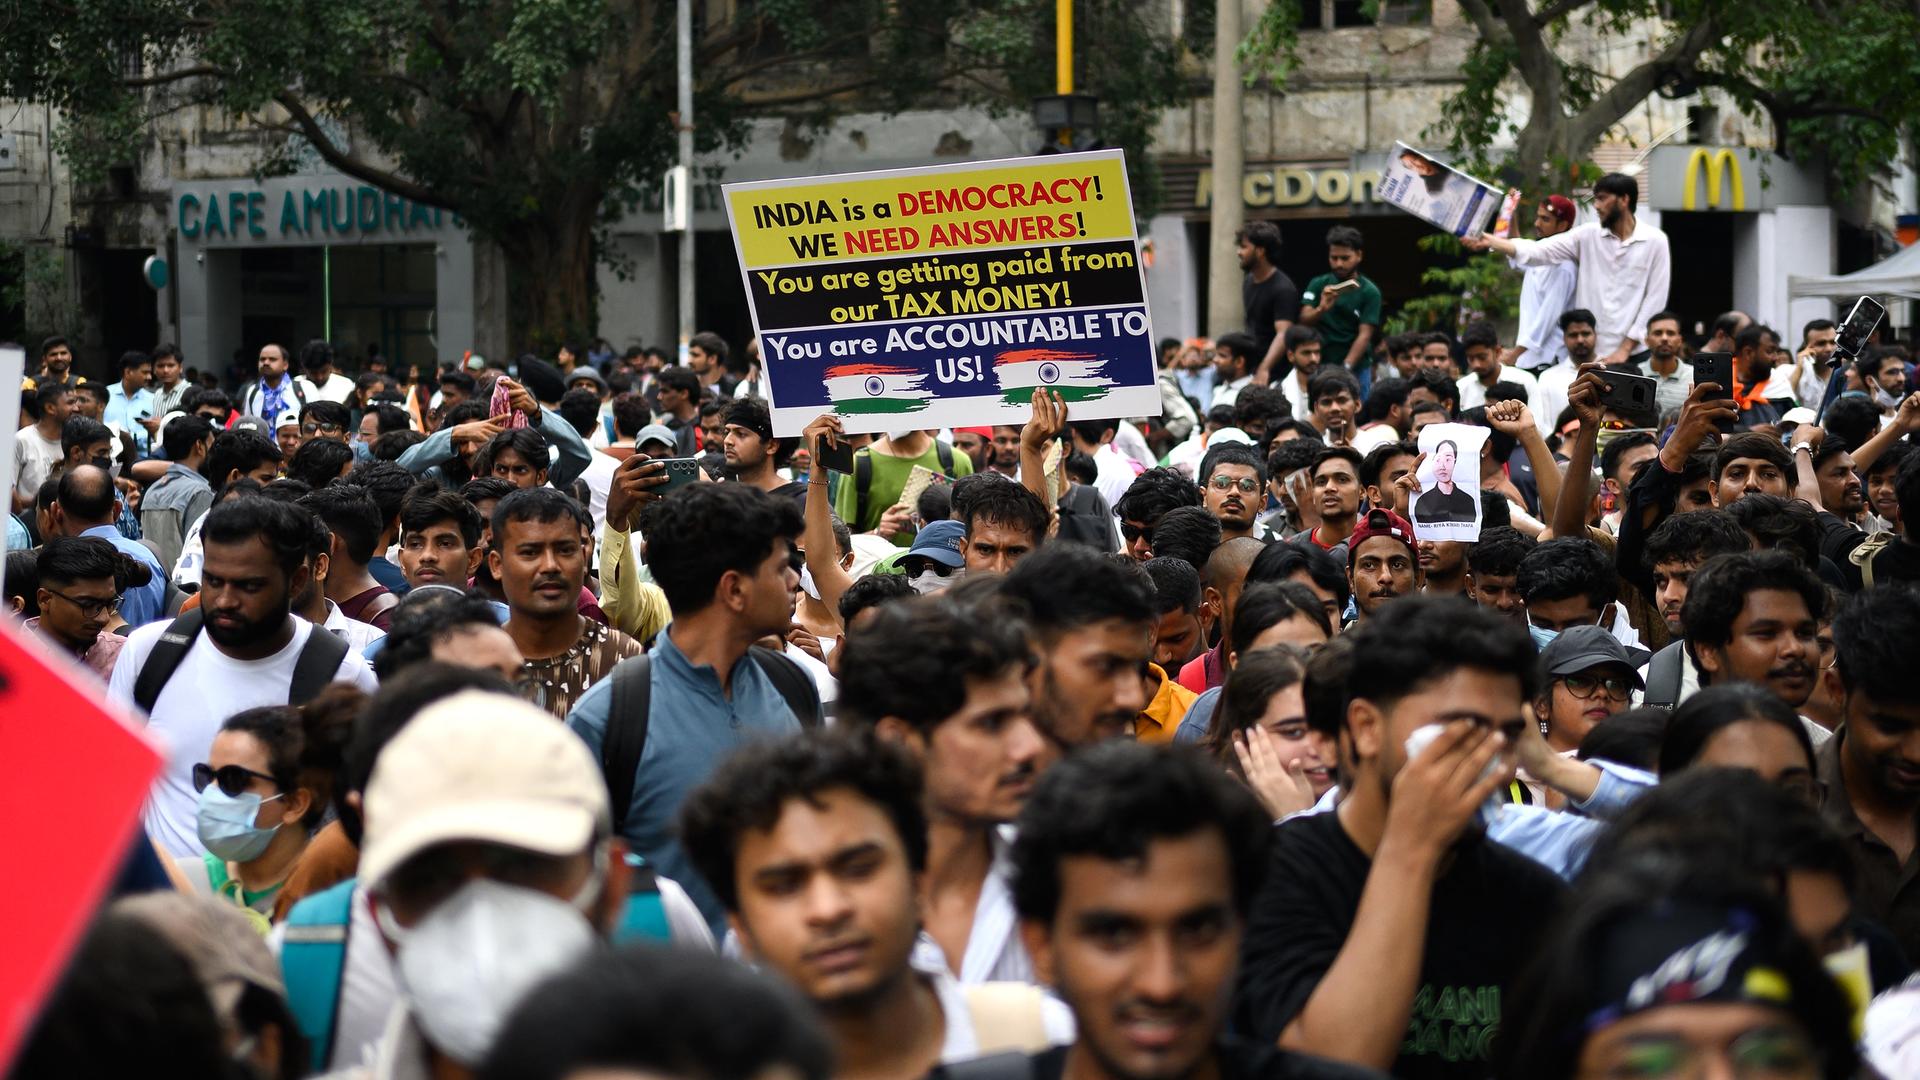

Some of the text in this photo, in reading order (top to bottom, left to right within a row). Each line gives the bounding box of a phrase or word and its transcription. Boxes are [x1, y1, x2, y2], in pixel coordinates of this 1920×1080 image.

[178, 191, 266, 239] CAFE
[753, 175, 1104, 229] INDIA is a DEMOCRACY!
[787, 211, 1087, 259] WE NEED ANSWERS!
[757, 245, 1134, 295] You are getting paid from
[830, 280, 1072, 323] our TAX MONEY!
[766, 309, 1149, 361] You are ACCOUNTABLE TO
[935, 355, 984, 384] US!
